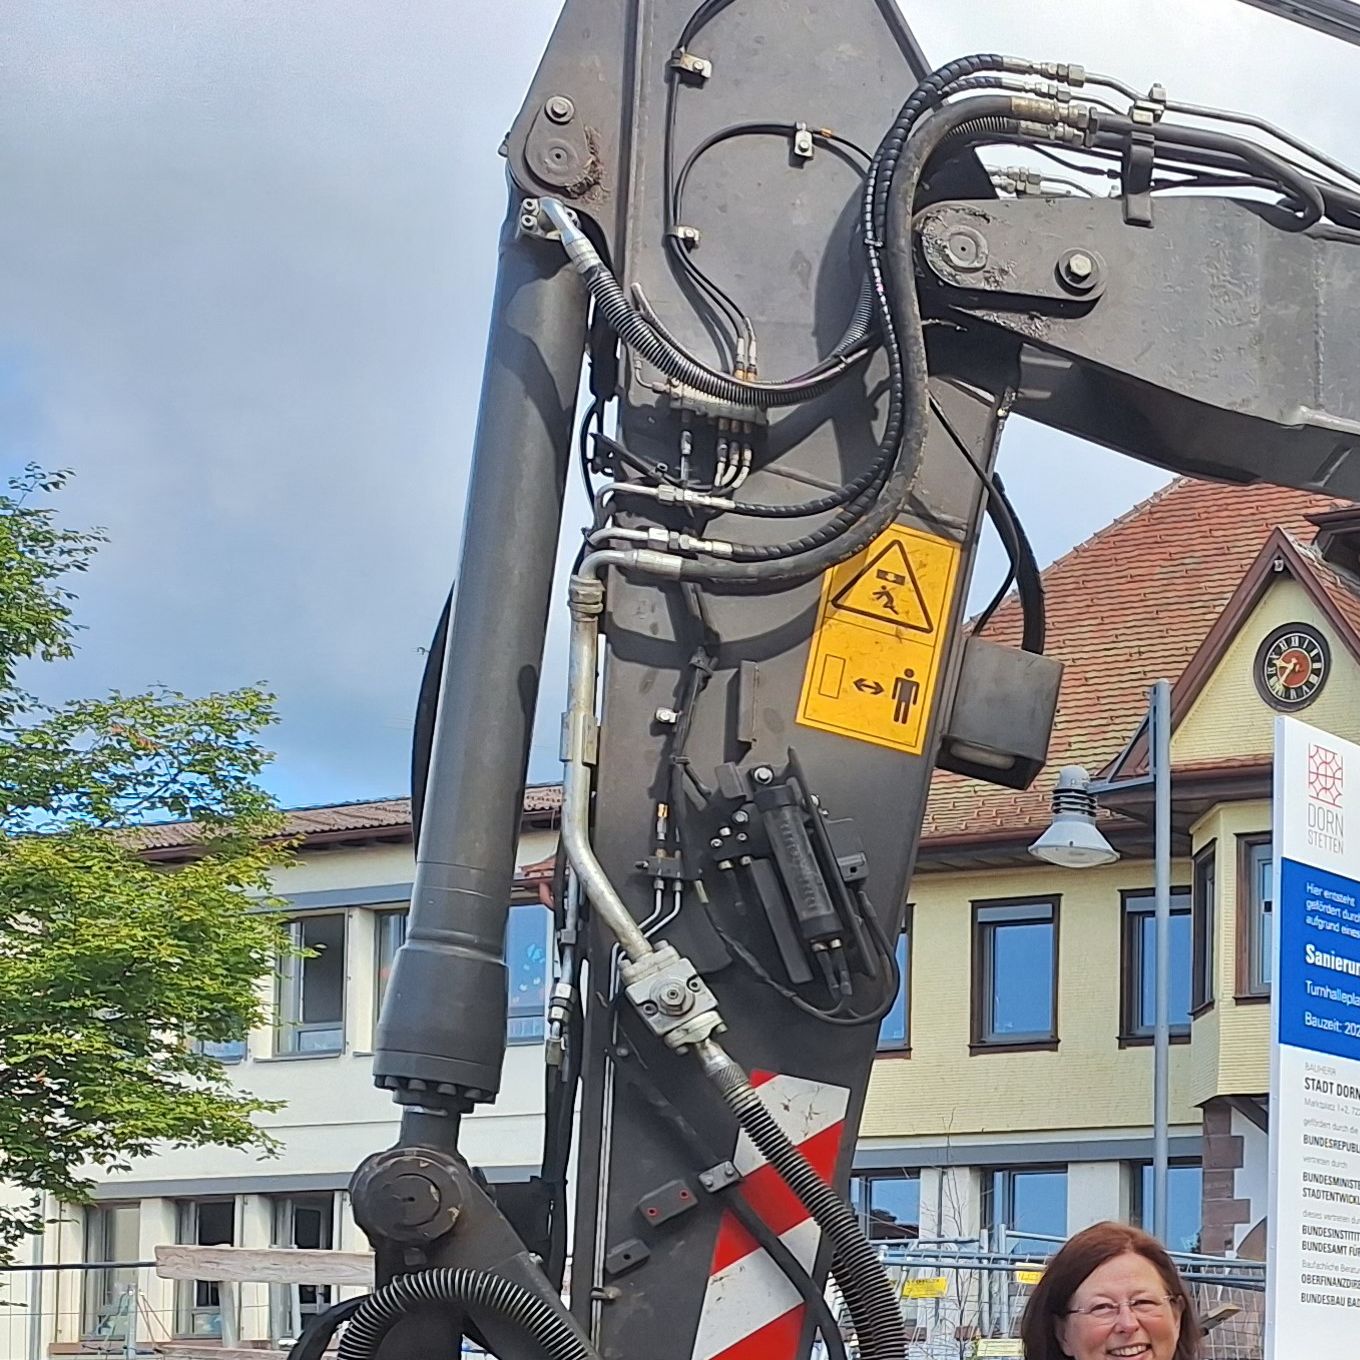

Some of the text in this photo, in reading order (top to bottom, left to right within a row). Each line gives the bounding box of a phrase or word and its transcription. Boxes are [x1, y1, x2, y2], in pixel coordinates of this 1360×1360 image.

[1307, 803, 1343, 838] DORN
[1307, 829, 1343, 855] STETTEN
[1306, 900, 1341, 917] gefördert
[1306, 915, 1340, 932] aufgrund
[1341, 924, 1360, 938] eines
[1305, 1011, 1342, 1033] Bauzeit:
[1304, 1077, 1334, 1095] STADT
[1302, 1240, 1347, 1256] BUNDESAMT
[1301, 1292, 1345, 1307] BUNDESBAU
